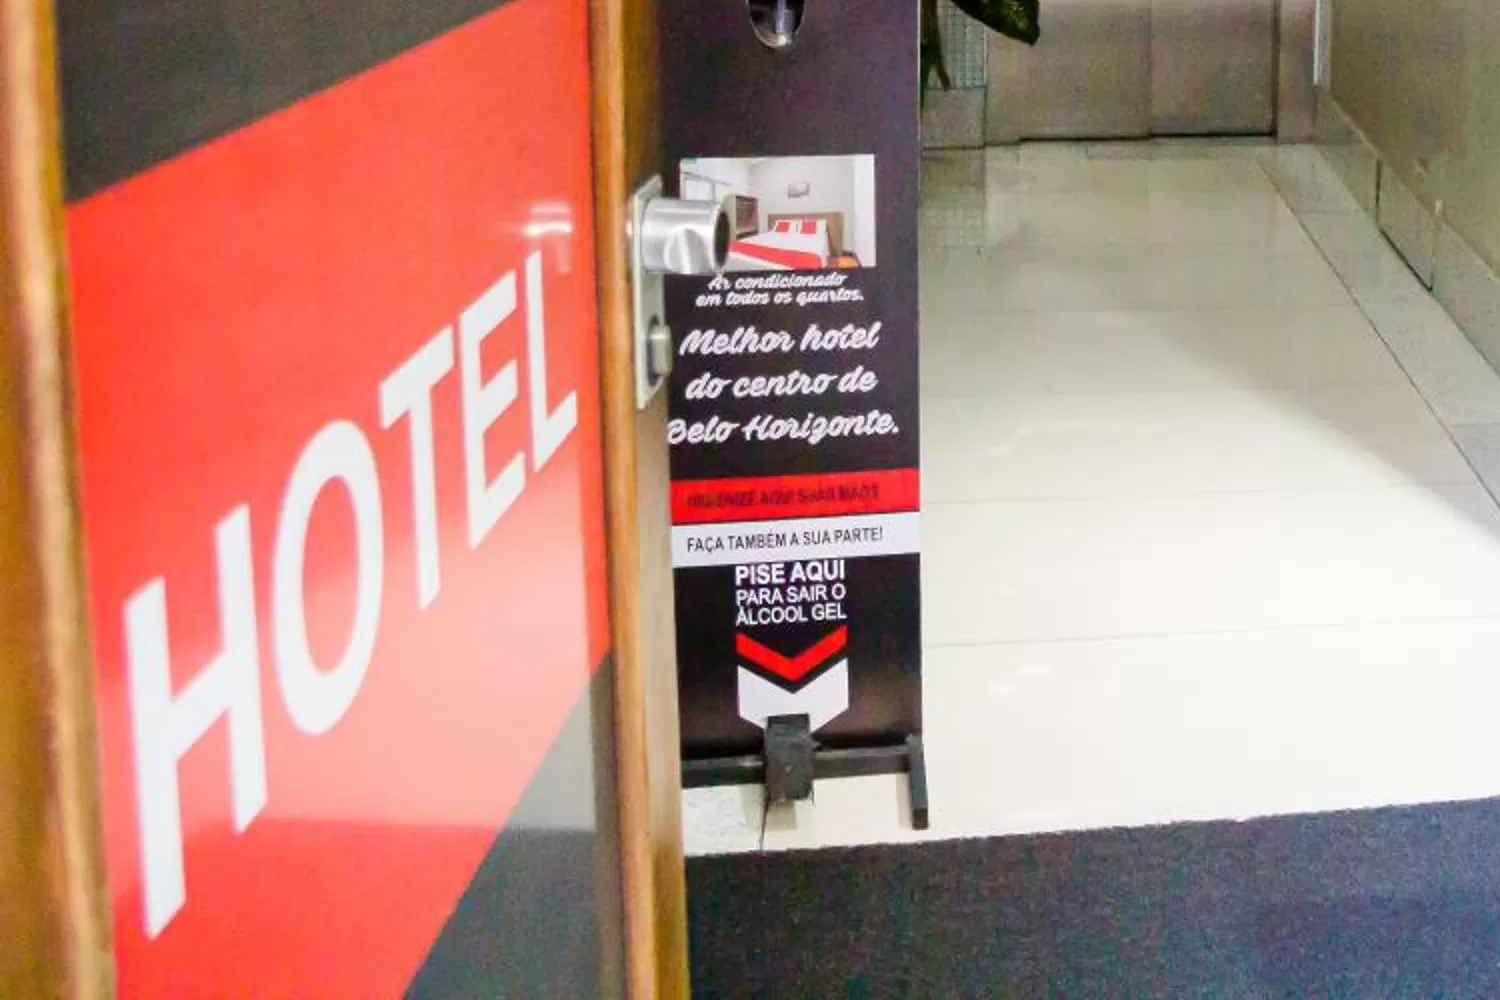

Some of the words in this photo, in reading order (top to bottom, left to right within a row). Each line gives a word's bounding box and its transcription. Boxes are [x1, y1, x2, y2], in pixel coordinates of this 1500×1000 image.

[735, 271, 848, 289] condicionado
[695, 295, 722, 307] em
[725, 289, 770, 305] todos
[774, 291, 792, 304] os
[795, 287, 865, 306] quartos.
[679, 325, 796, 356] Melhor
[800, 321, 882, 352] hotel
[685, 372, 732, 400] do
[732, 370, 839, 398] centro
[837, 365, 879, 393] de
[667, 415, 740, 444] Belo
[741, 409, 900, 445] Horizonte.
[687, 536, 725, 554] FAÇA
[728, 529, 788, 550] TAMBÉM
[789, 532, 801, 546] A
[803, 529, 834, 546] SUA
[835, 526, 884, 544] PARTE!
[735, 564, 785, 587] PISE
[790, 559, 846, 584] AQUI
[123, 250, 578, 942] HOTEL
[736, 588, 783, 606] PARA
[787, 585, 827, 602] SAIR
[831, 583, 847, 598] O
[811, 602, 847, 620] GEL
